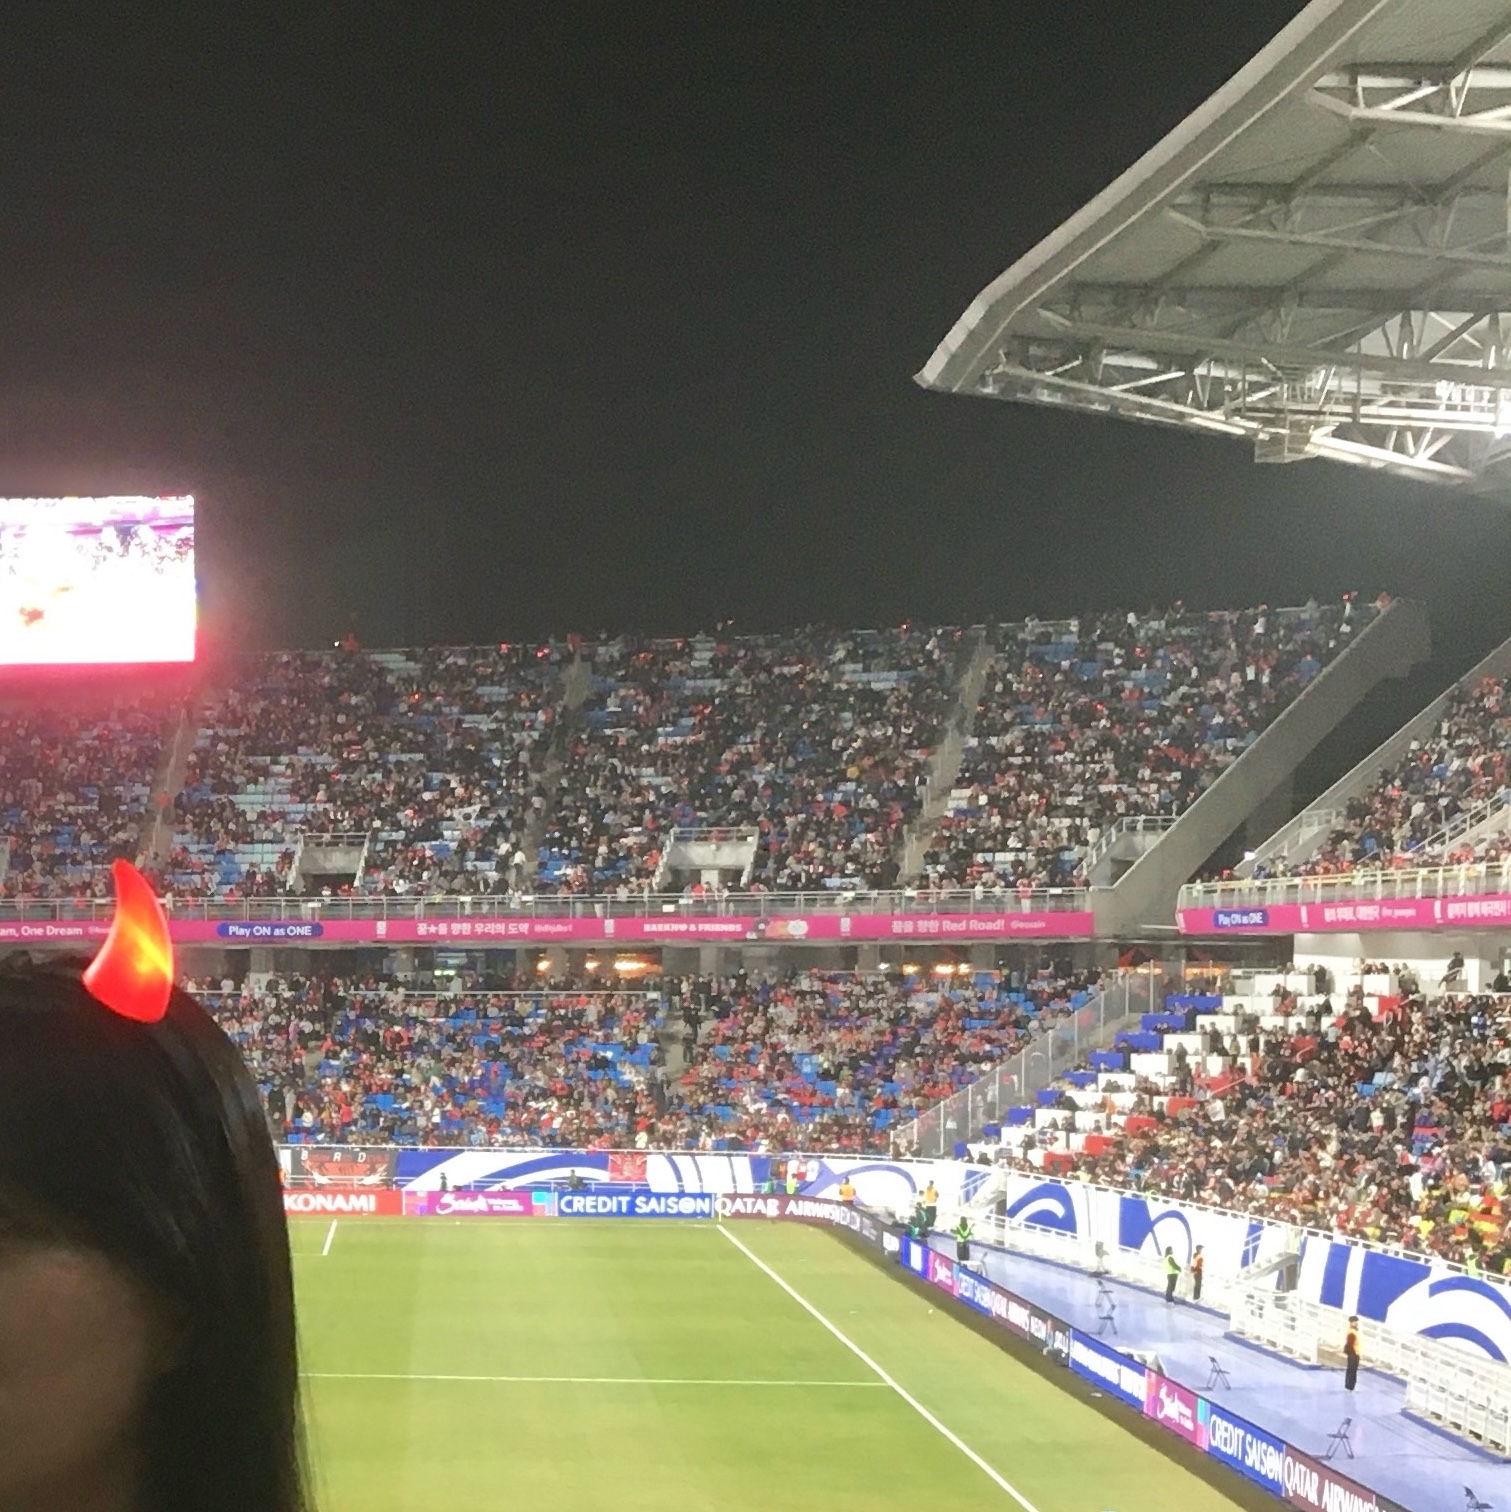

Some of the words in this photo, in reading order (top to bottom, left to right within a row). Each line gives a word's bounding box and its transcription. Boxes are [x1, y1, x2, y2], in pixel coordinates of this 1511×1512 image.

[21, 926, 43, 937] One
[46, 926, 83, 937] Dream
[228, 925, 250, 938] Play
[252, 926, 271, 937] ON
[273, 928, 286, 937] as
[286, 926, 312, 937] ONE
[698, 923, 743, 933] FRIENDS
[942, 919, 967, 932] Red
[969, 919, 1005, 932] Road!
[357, 1151, 367, 1163] D
[284, 1193, 376, 1212] KONAMI
[560, 1195, 631, 1213] CREDIT
[634, 1196, 710, 1214] SAISON
[714, 1197, 779, 1217] QATAR
[1209, 1414, 1245, 1461] CREDIT
[1245, 1433, 1284, 1486] SAISON
[1284, 1456, 1319, 1507] QATAR
